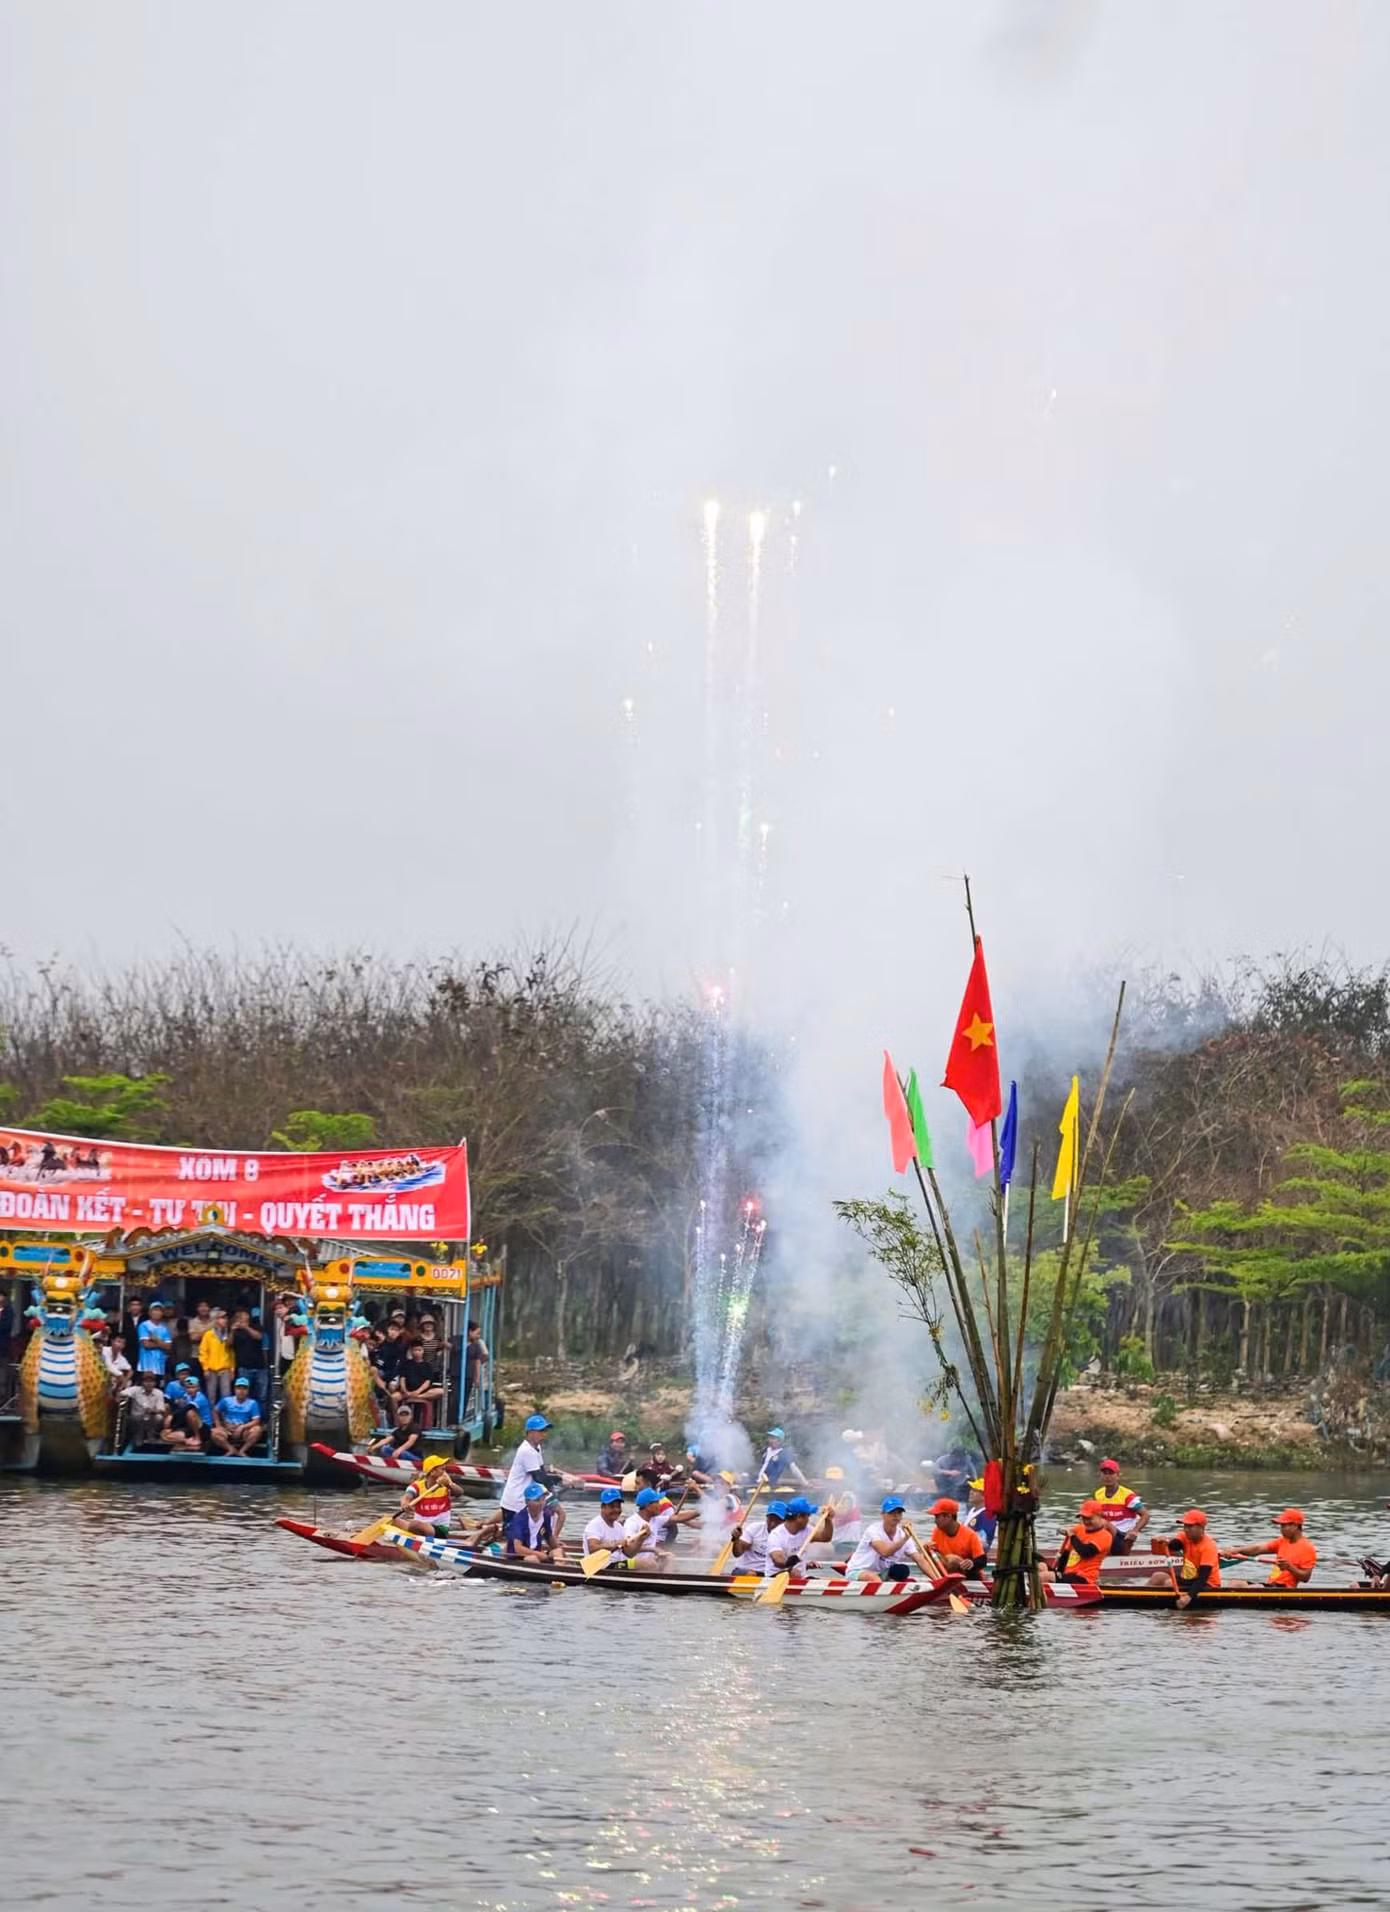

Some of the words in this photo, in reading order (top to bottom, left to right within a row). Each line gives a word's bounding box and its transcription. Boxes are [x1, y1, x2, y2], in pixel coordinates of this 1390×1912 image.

[244, 1159, 259, 1181] 8
[0, 1188, 70, 1221] ĐOÀN
[76, 1186, 127, 1223] KẾT
[191, 1200, 237, 1227] TN
[260, 1193, 343, 1234] QUYẾT
[348, 1193, 435, 1231] THẮNG
[432, 1268, 461, 1279] 0071
